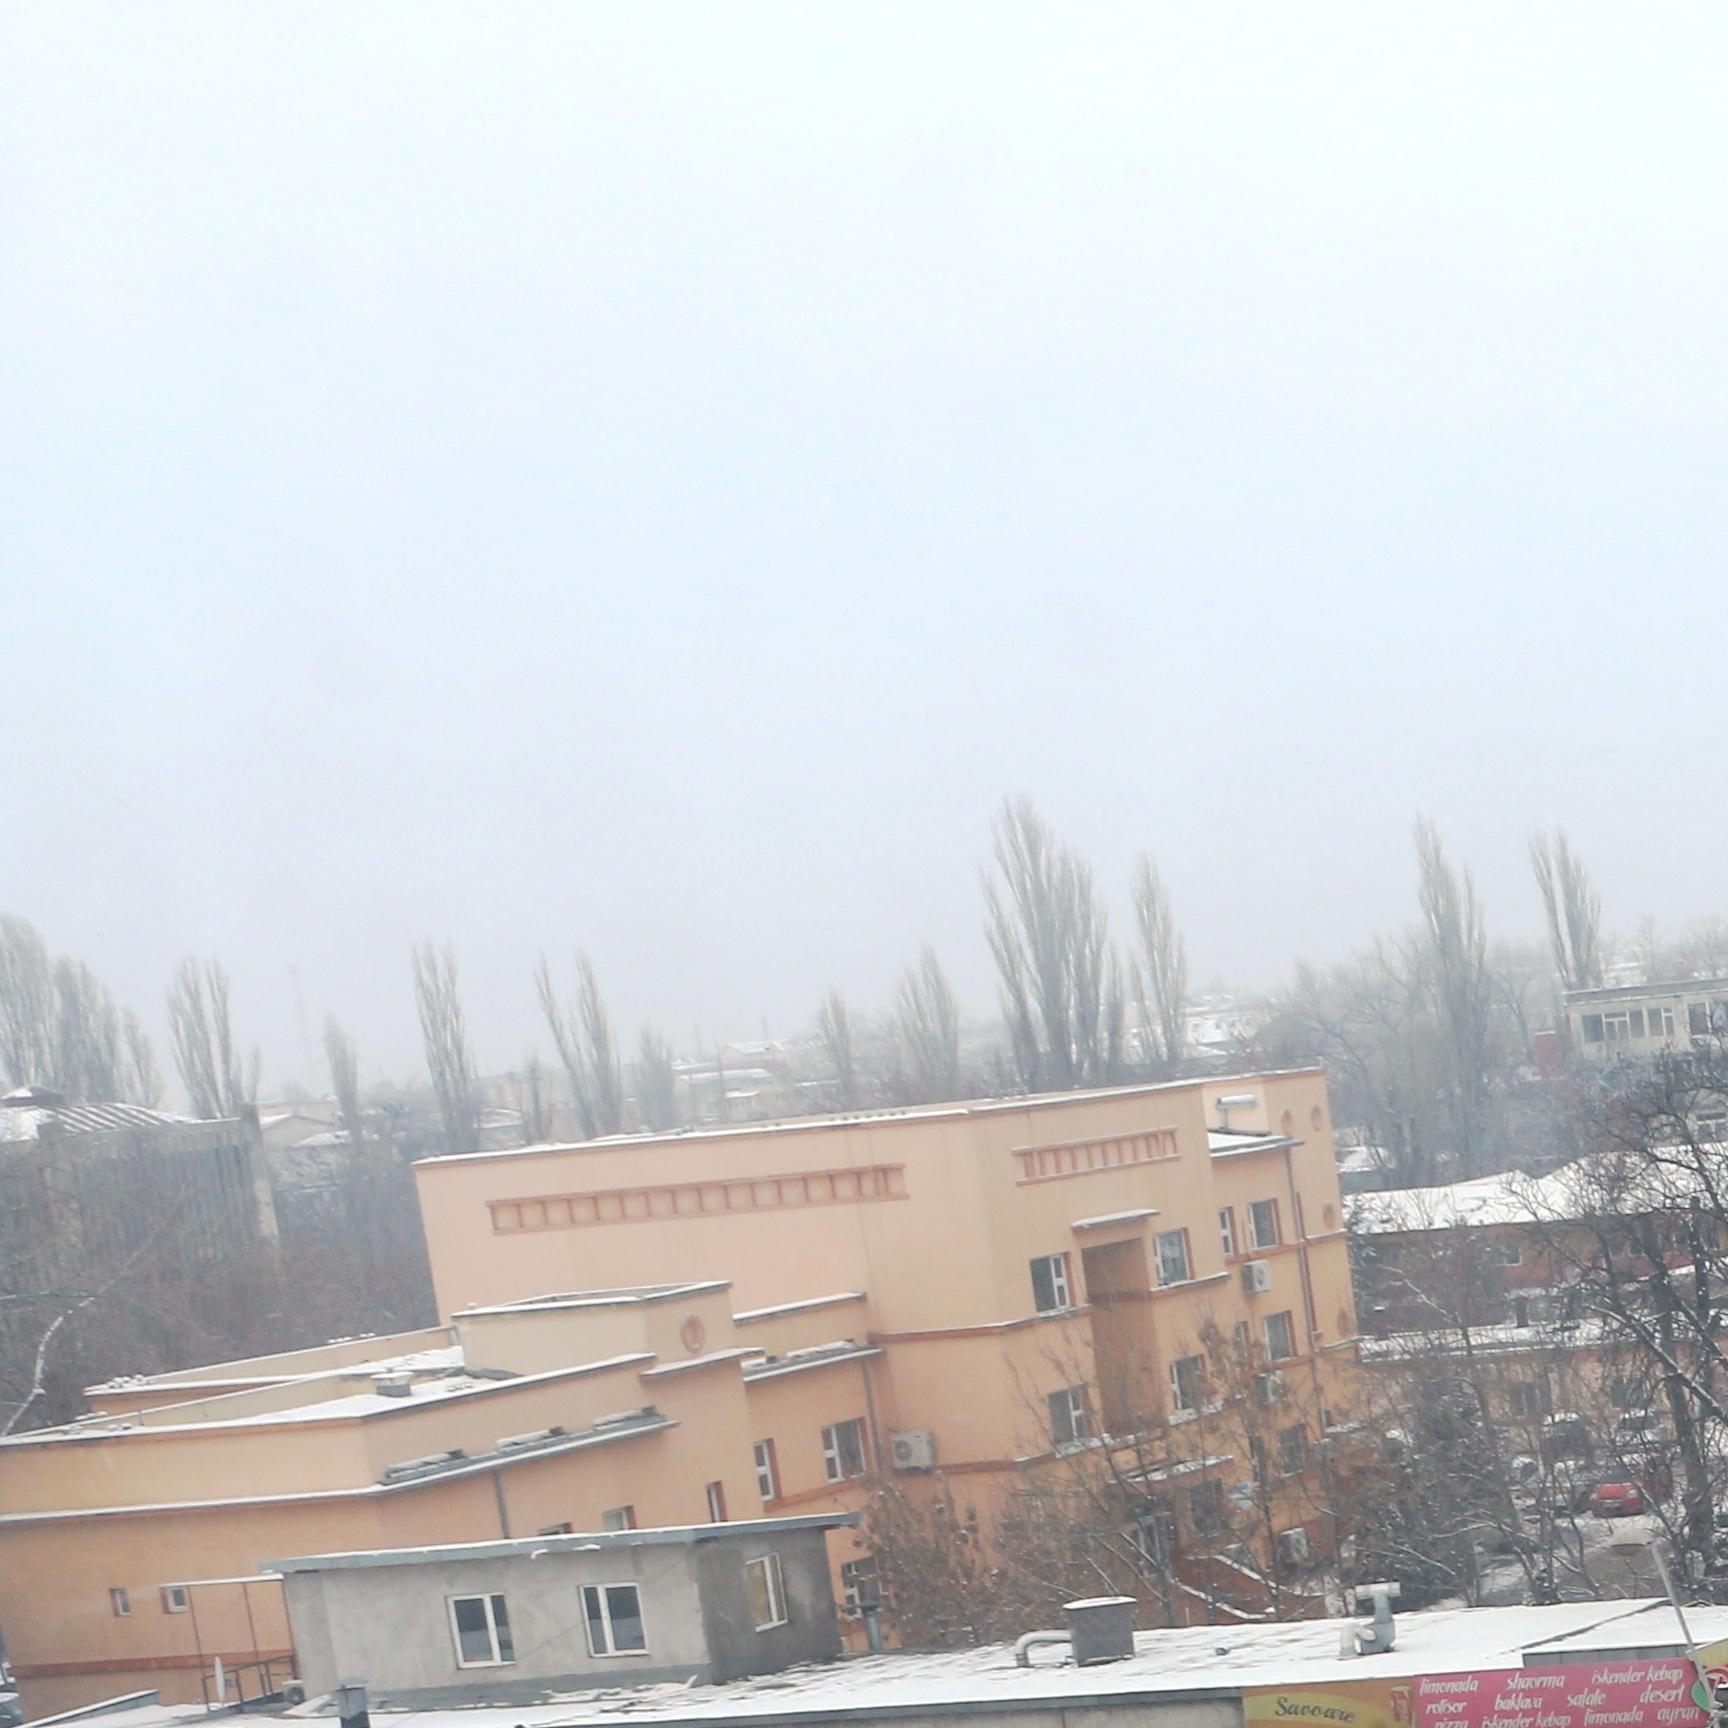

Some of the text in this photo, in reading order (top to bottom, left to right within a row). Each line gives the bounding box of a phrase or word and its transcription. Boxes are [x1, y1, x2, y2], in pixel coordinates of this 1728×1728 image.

[1420, 1662, 1684, 1694] limonada shaorma iskender kebap
[1275, 1696, 1355, 1723] Savoare
[1535, 1710, 1571, 1727] kebap
[1584, 1706, 1644, 1727] limonada
[1657, 1705, 1700, 1721] ayran
